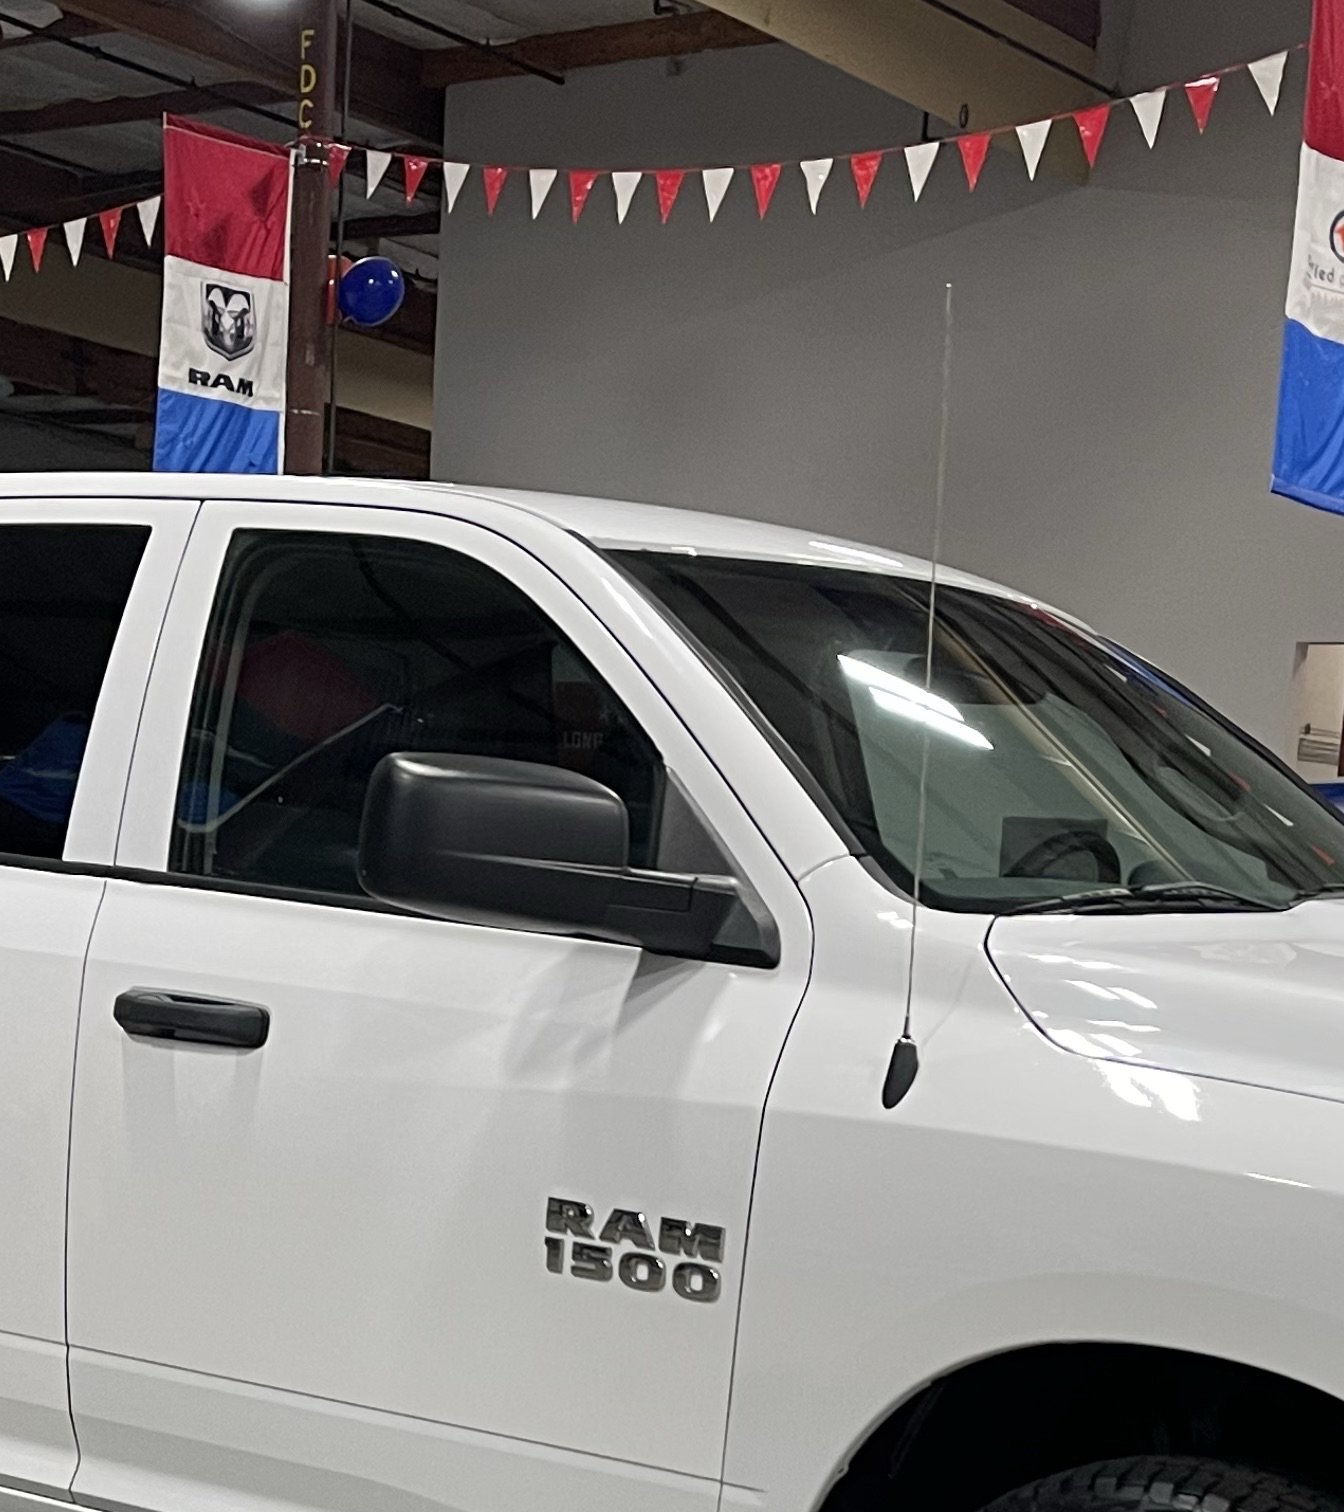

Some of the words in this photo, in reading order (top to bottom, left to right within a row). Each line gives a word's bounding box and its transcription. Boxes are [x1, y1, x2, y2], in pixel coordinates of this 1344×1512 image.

[299, 29, 317, 128] FDC
[188, 367, 255, 398] RAM
[545, 1197, 726, 1263] RAM
[544, 1236, 722, 1303] 1500
